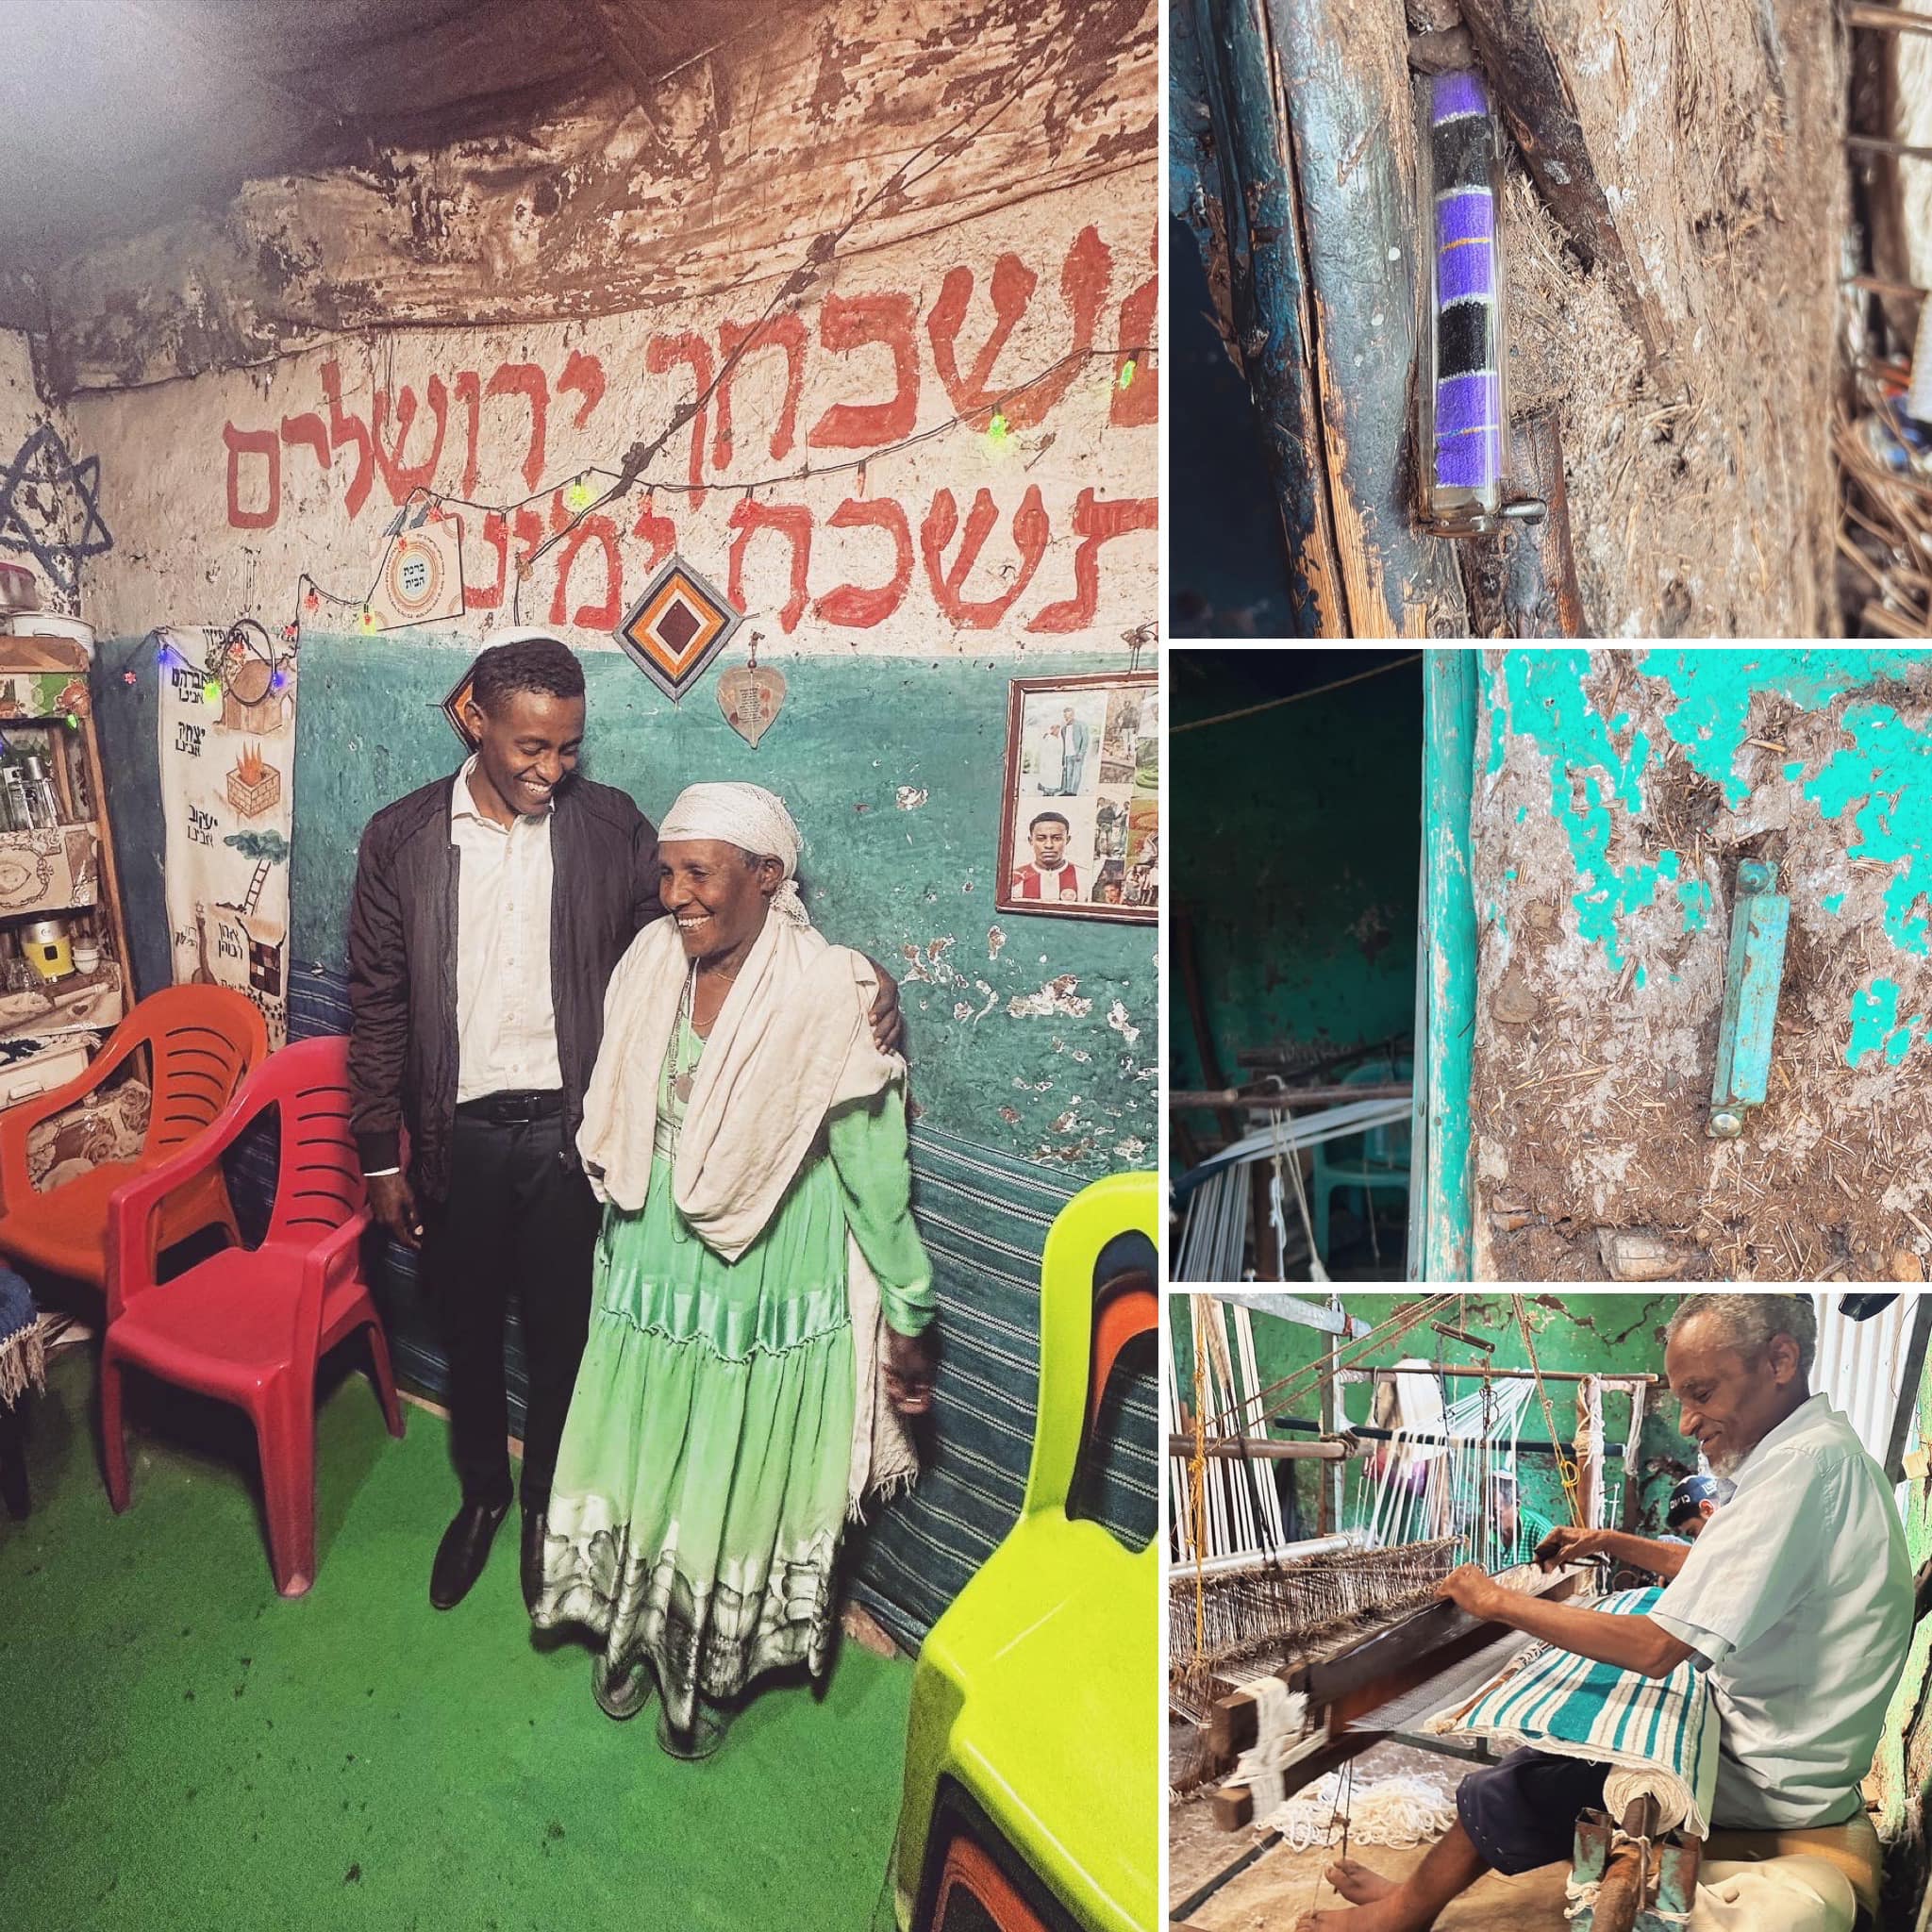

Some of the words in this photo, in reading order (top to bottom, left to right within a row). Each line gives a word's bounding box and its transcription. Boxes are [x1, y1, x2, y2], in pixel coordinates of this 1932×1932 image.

[224, 349, 606, 528] ירושלים
[404, 563, 425, 576] ברכת
[406, 576, 425, 590] הבית
[178, 687, 204, 704] אבינו
[178, 722, 206, 744] יצחק
[175, 739, 201, 757] אבינו
